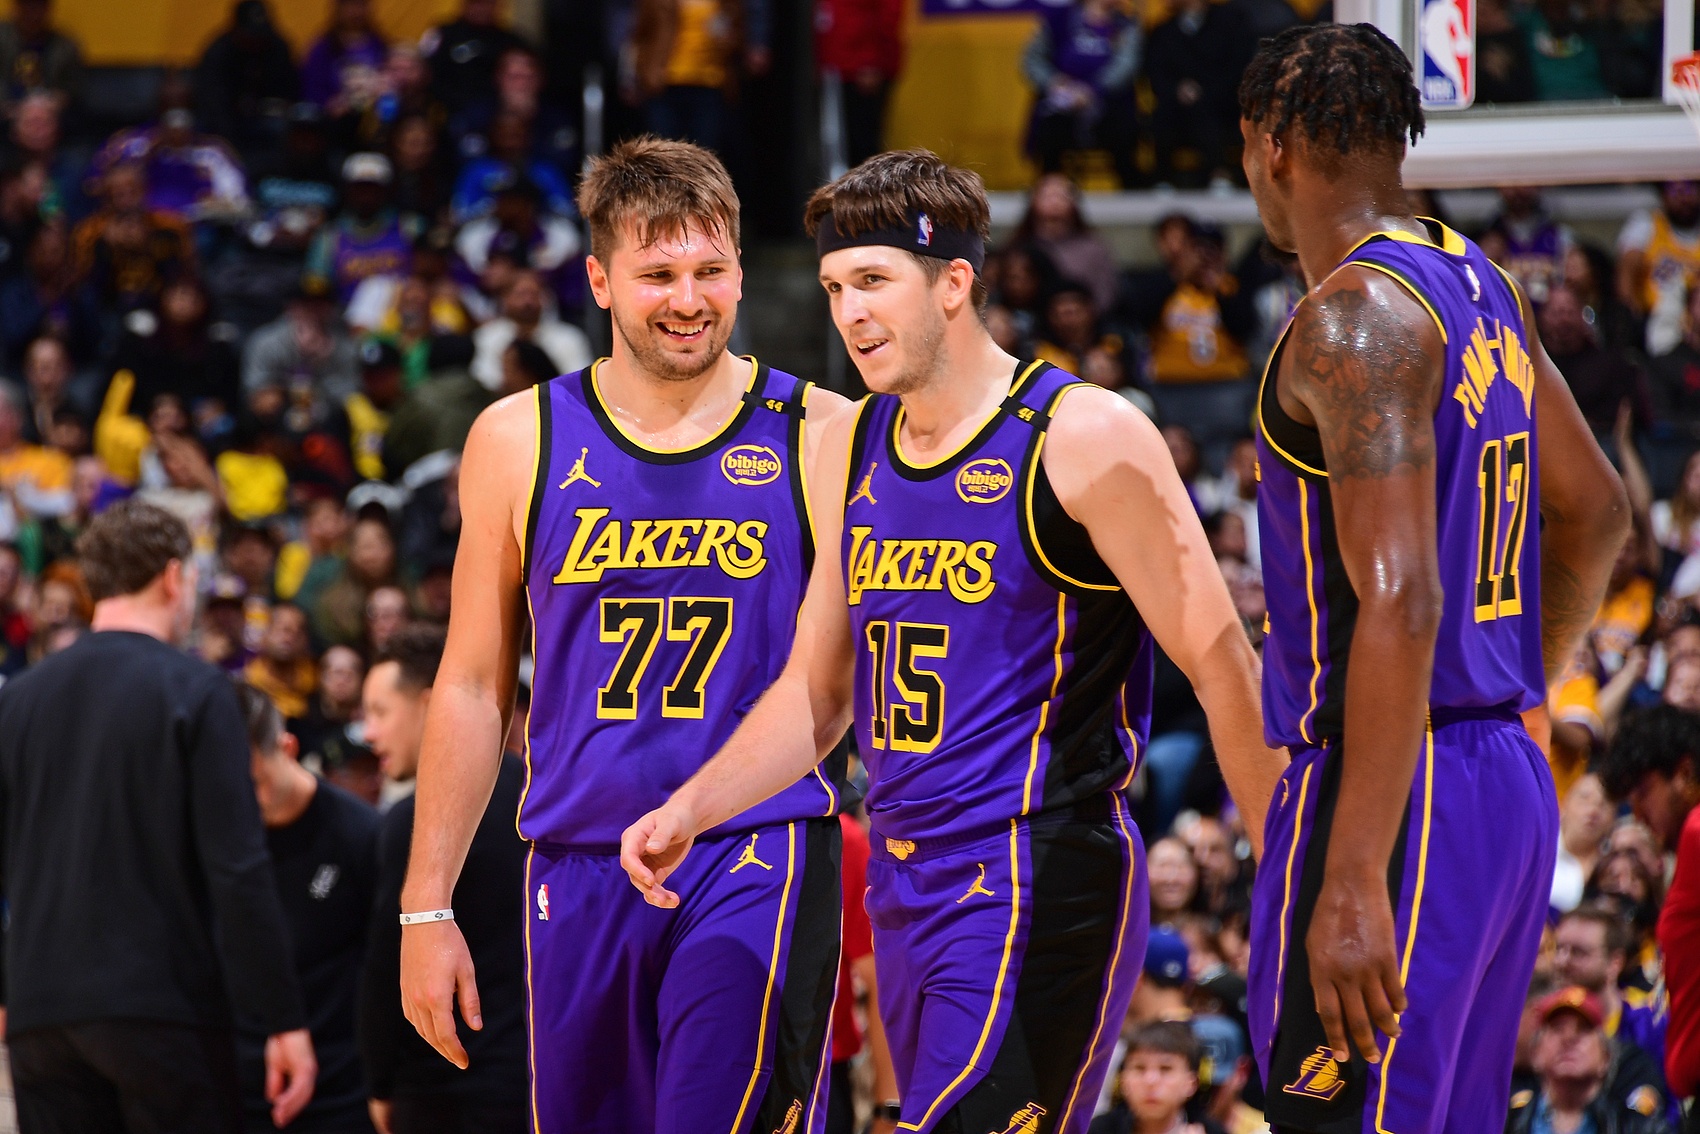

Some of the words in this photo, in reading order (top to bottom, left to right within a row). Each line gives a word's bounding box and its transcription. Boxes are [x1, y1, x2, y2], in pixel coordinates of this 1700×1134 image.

[765, 399, 784, 413] 44
[1017, 407, 1036, 422] 44
[726, 454, 778, 475] bibigo
[960, 469, 1010, 490] bibigo
[553, 507, 769, 585] LAKERS
[848, 525, 998, 606] LAKERS
[1474, 431, 1530, 623] 17
[596, 597, 734, 720] 77
[865, 620, 950, 754] 15
